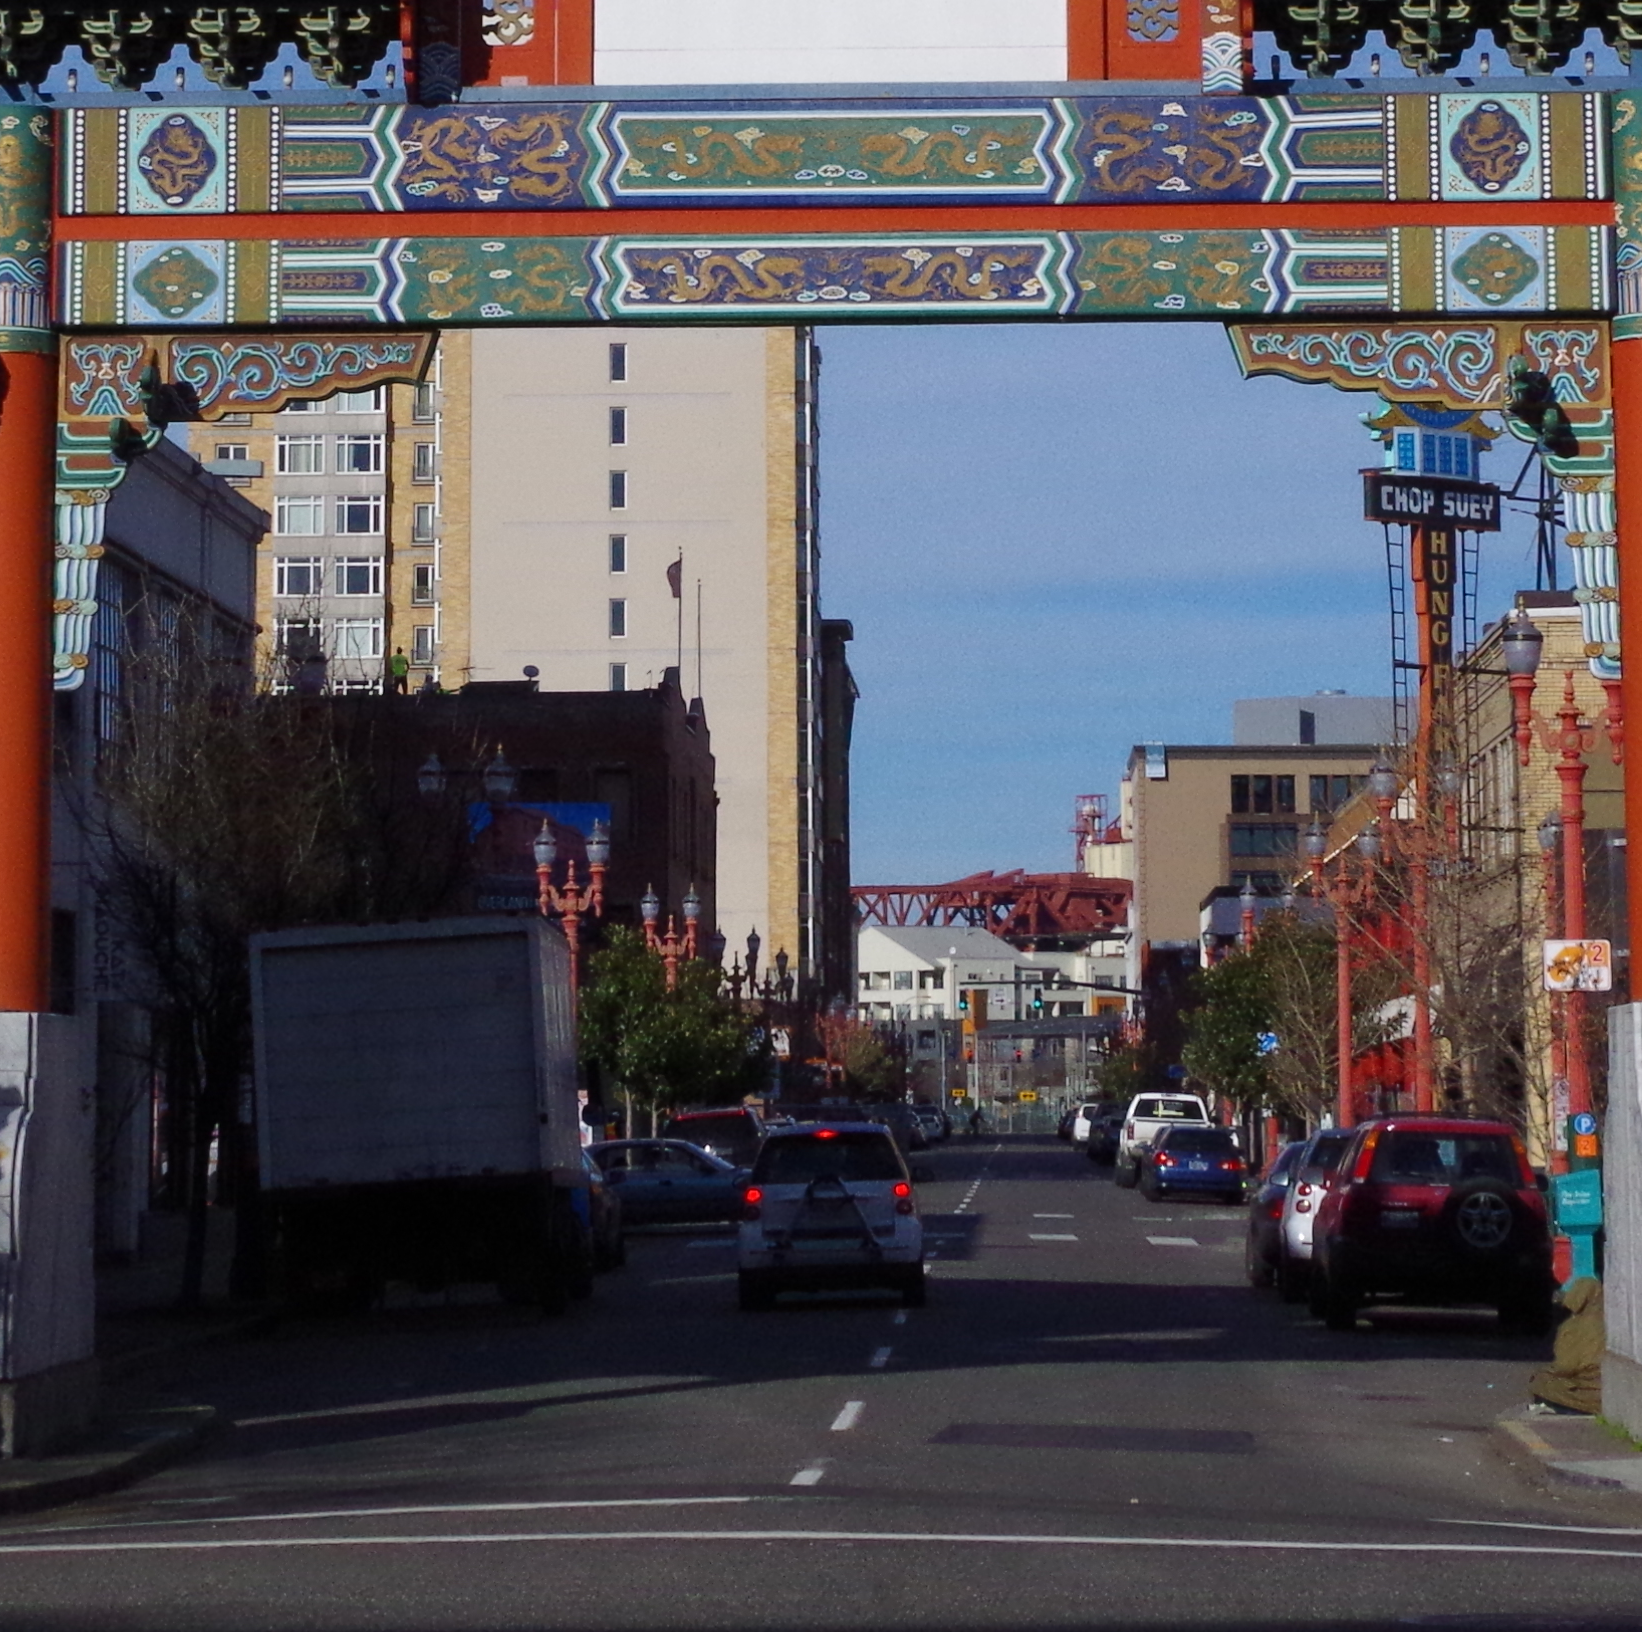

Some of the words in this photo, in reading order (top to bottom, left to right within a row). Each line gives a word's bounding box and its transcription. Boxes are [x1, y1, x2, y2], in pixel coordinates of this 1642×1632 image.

[1381, 485, 1435, 515] CHOP
[1443, 490, 1494, 521] SUEY
[1430, 530, 1450, 646] HUNG
[1592, 945, 1602, 962] 2
[1580, 1117, 1591, 1133] P
